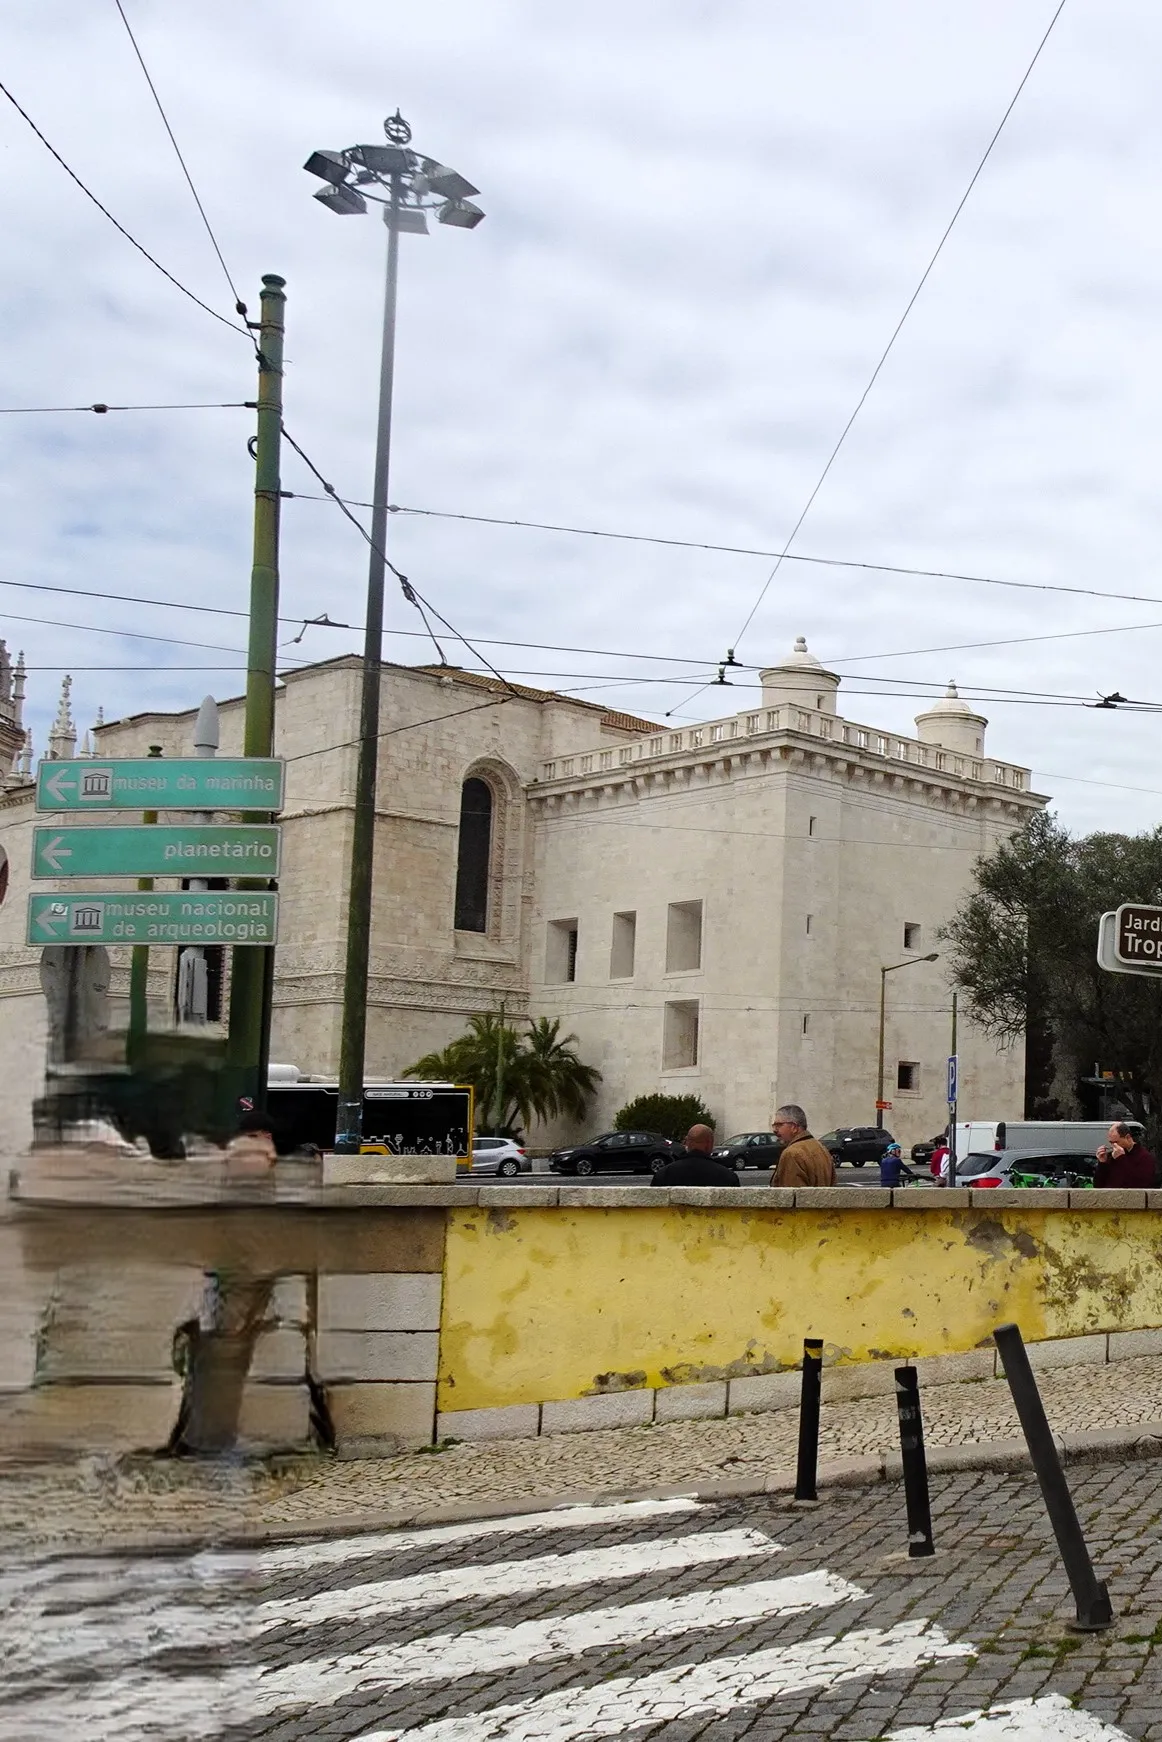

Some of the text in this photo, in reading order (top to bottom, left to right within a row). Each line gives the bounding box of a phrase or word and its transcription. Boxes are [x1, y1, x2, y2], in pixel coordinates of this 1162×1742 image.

[113, 774, 274, 790] museu da marinha
[164, 841, 273, 860] planetário
[105, 900, 269, 916] museu nacional
[112, 921, 269, 940] de arqueologia
